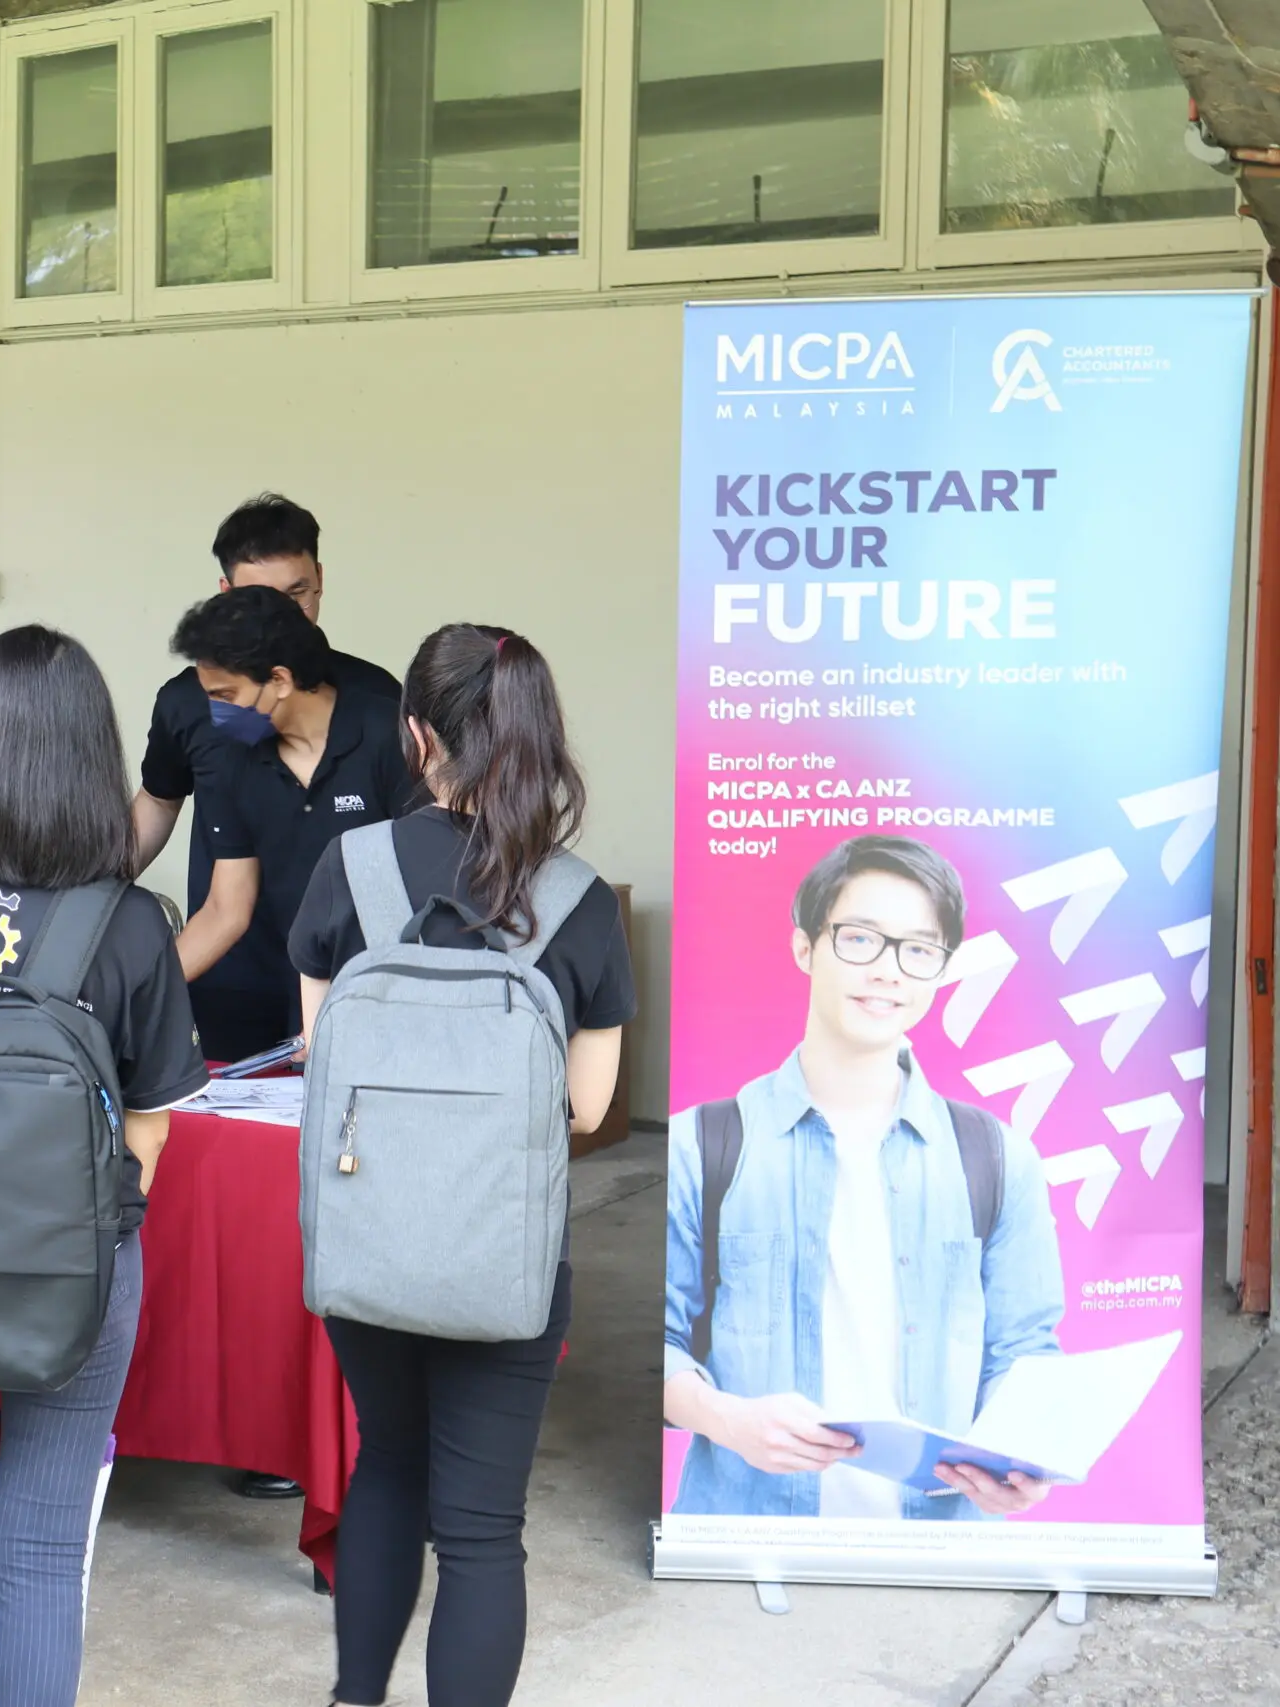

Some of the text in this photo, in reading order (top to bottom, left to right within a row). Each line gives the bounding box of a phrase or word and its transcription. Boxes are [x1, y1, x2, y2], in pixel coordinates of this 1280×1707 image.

[715, 331, 915, 382] MICPA
[1062, 344, 1155, 359] CHARTERED
[1062, 358, 1172, 372] ACCOUNTANTS
[715, 399, 915, 419] MALAYSIA
[715, 468, 1058, 517] KICKSTART
[712, 526, 888, 571] YOUR
[713, 578, 1057, 644] FUTURE
[708, 659, 1128, 692] Become an industry leader with
[708, 693, 917, 726] the right skillset
[707, 752, 836, 771] Enrol for the
[707, 780, 791, 800] MICPA
[796, 784, 811, 799] x
[707, 806, 1056, 830] QUALIFYING PROGRAMME
[707, 836, 777, 859] today!
[1081, 1274, 1184, 1298] @theMICPA
[1080, 1294, 1184, 1312] micpa.com.my
